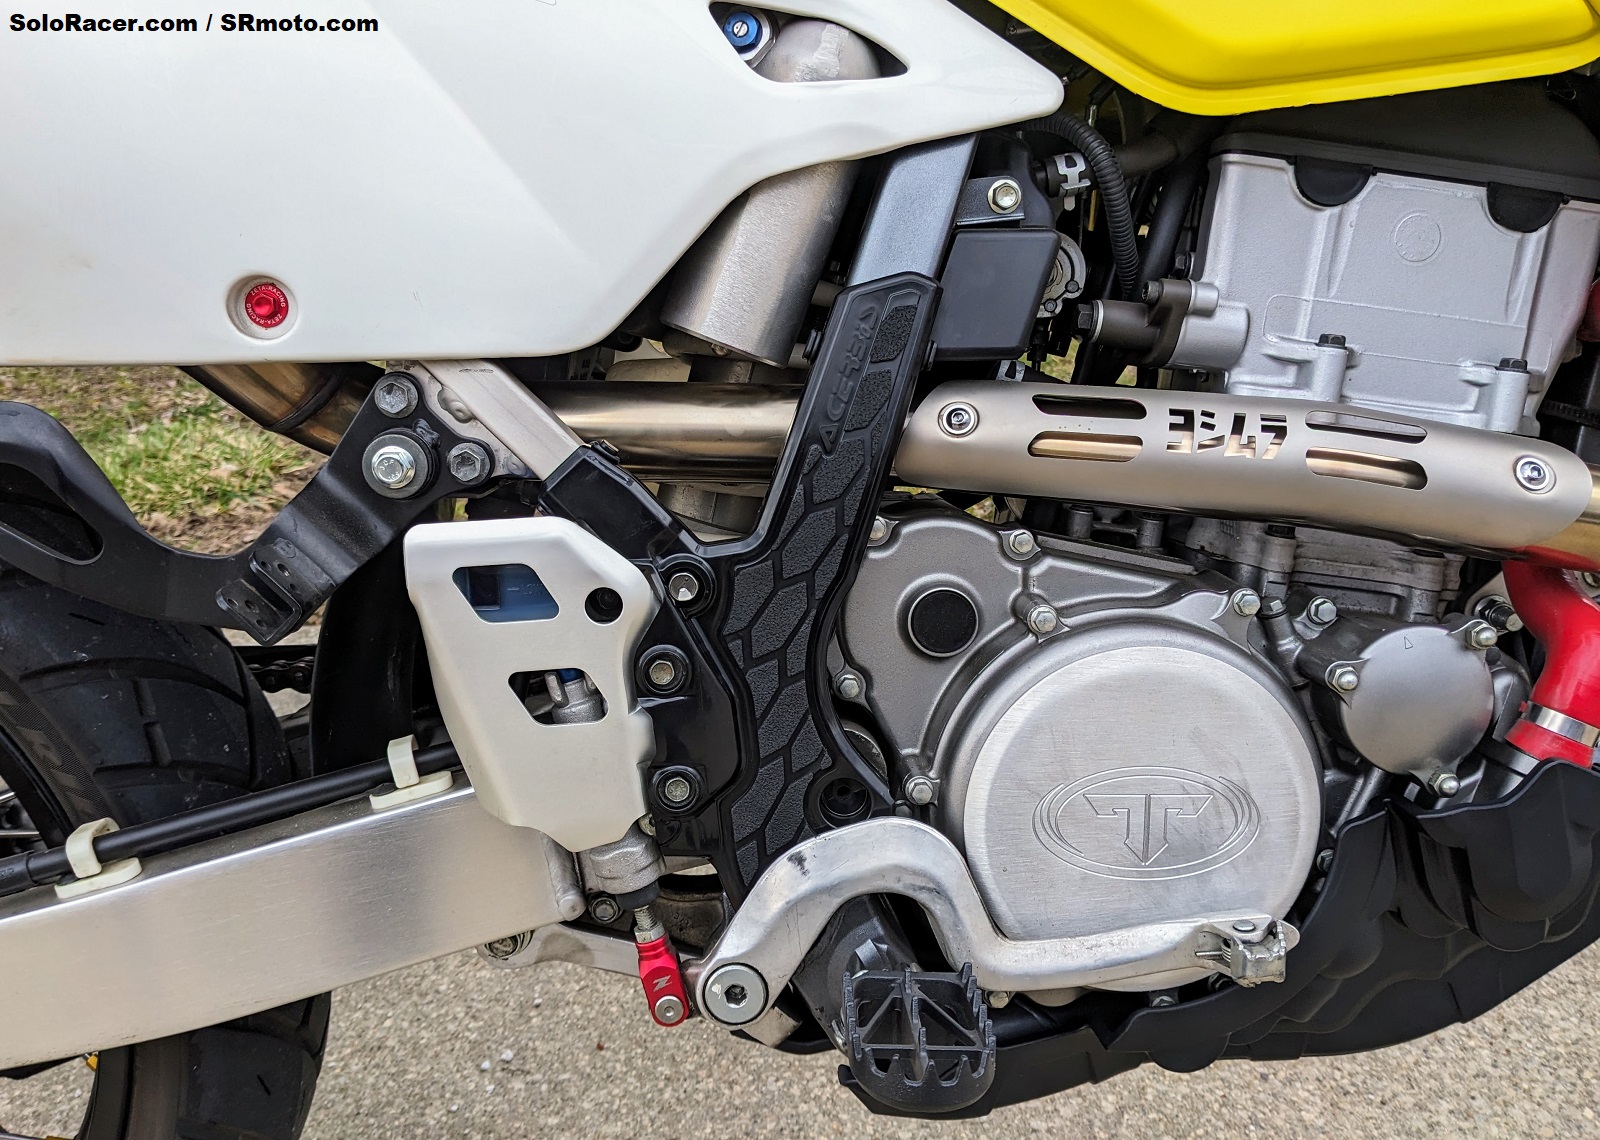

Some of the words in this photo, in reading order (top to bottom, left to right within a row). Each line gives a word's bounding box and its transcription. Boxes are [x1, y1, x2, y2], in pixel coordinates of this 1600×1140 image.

[250, 285, 286, 307] ZETA-RACING
[1166, 408, 1288, 460] ヨシムラ
